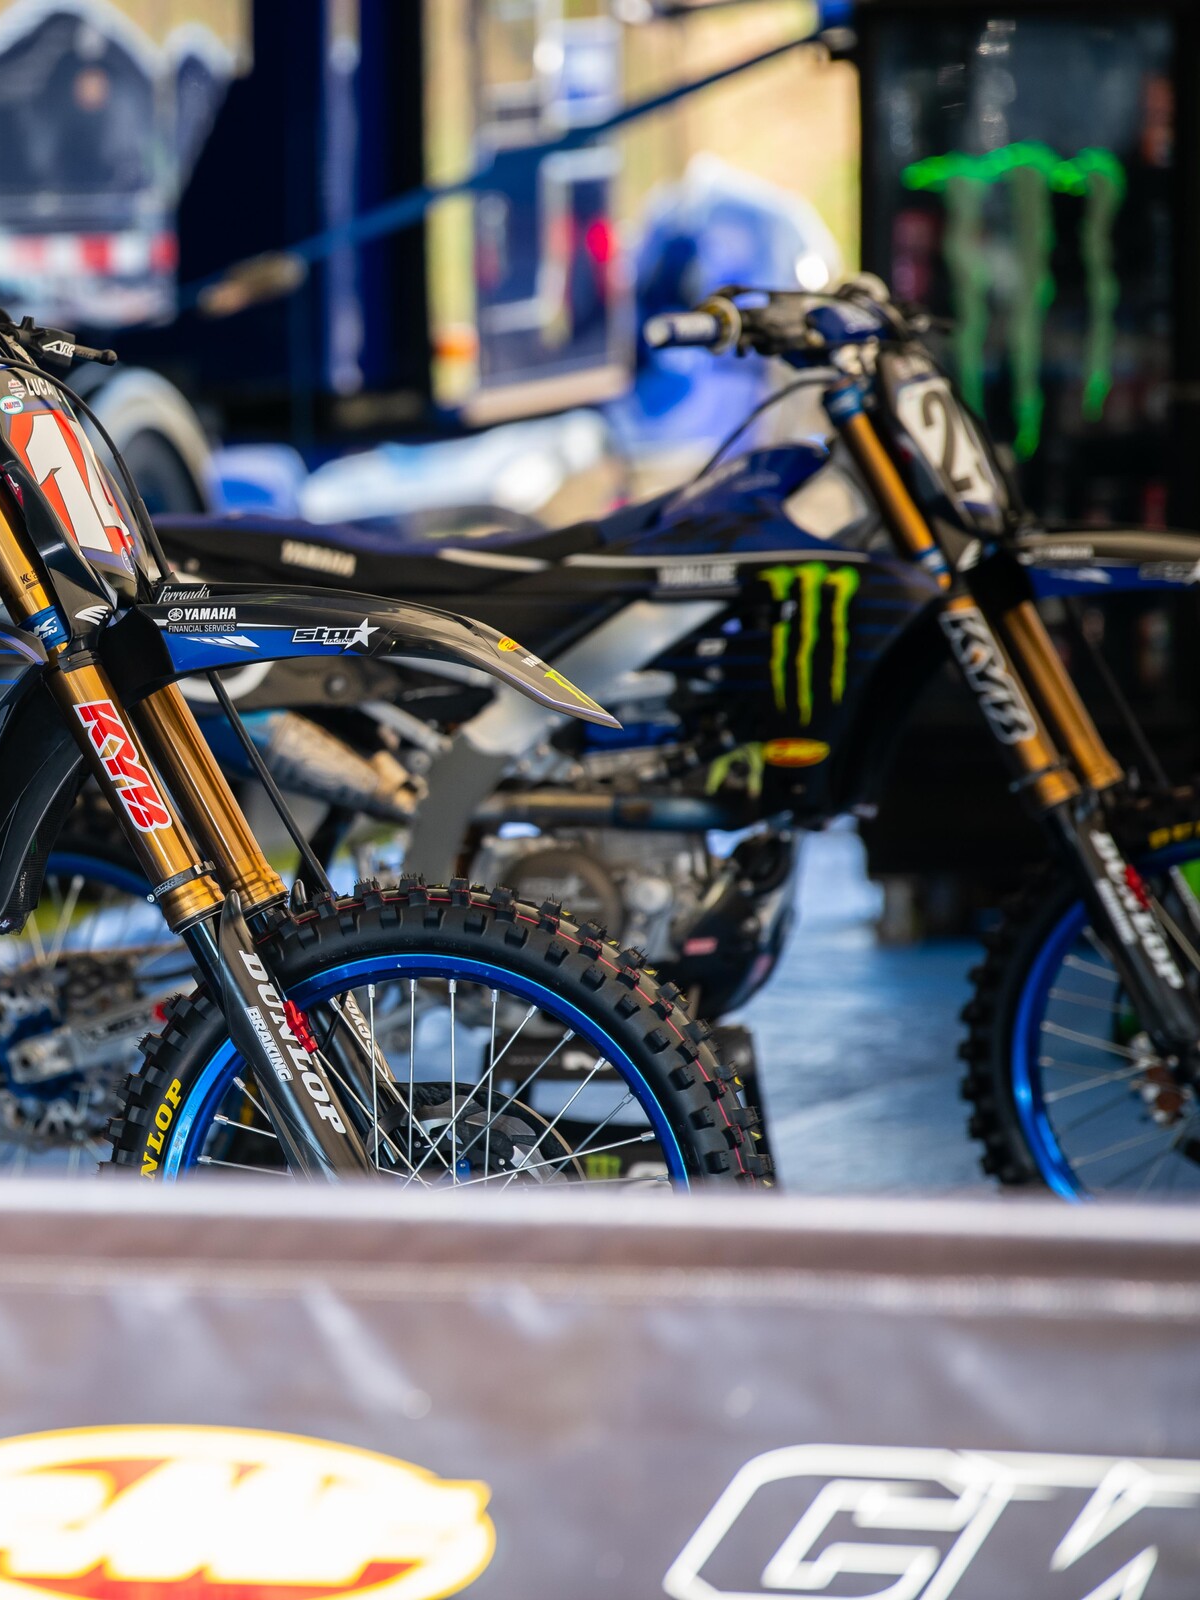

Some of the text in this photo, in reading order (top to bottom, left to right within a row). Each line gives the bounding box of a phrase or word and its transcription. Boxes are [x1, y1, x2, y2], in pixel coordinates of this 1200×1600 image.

[157, 584, 211, 604] Ferrandis
[184, 607, 237, 620] YAMAHA
[168, 623, 235, 633] FINANCIAL SERVICES
[239, 950, 346, 1134] DUNLOP
[245, 1007, 292, 1081] BRAKING
[139, 1078, 182, 1183] NLOP
